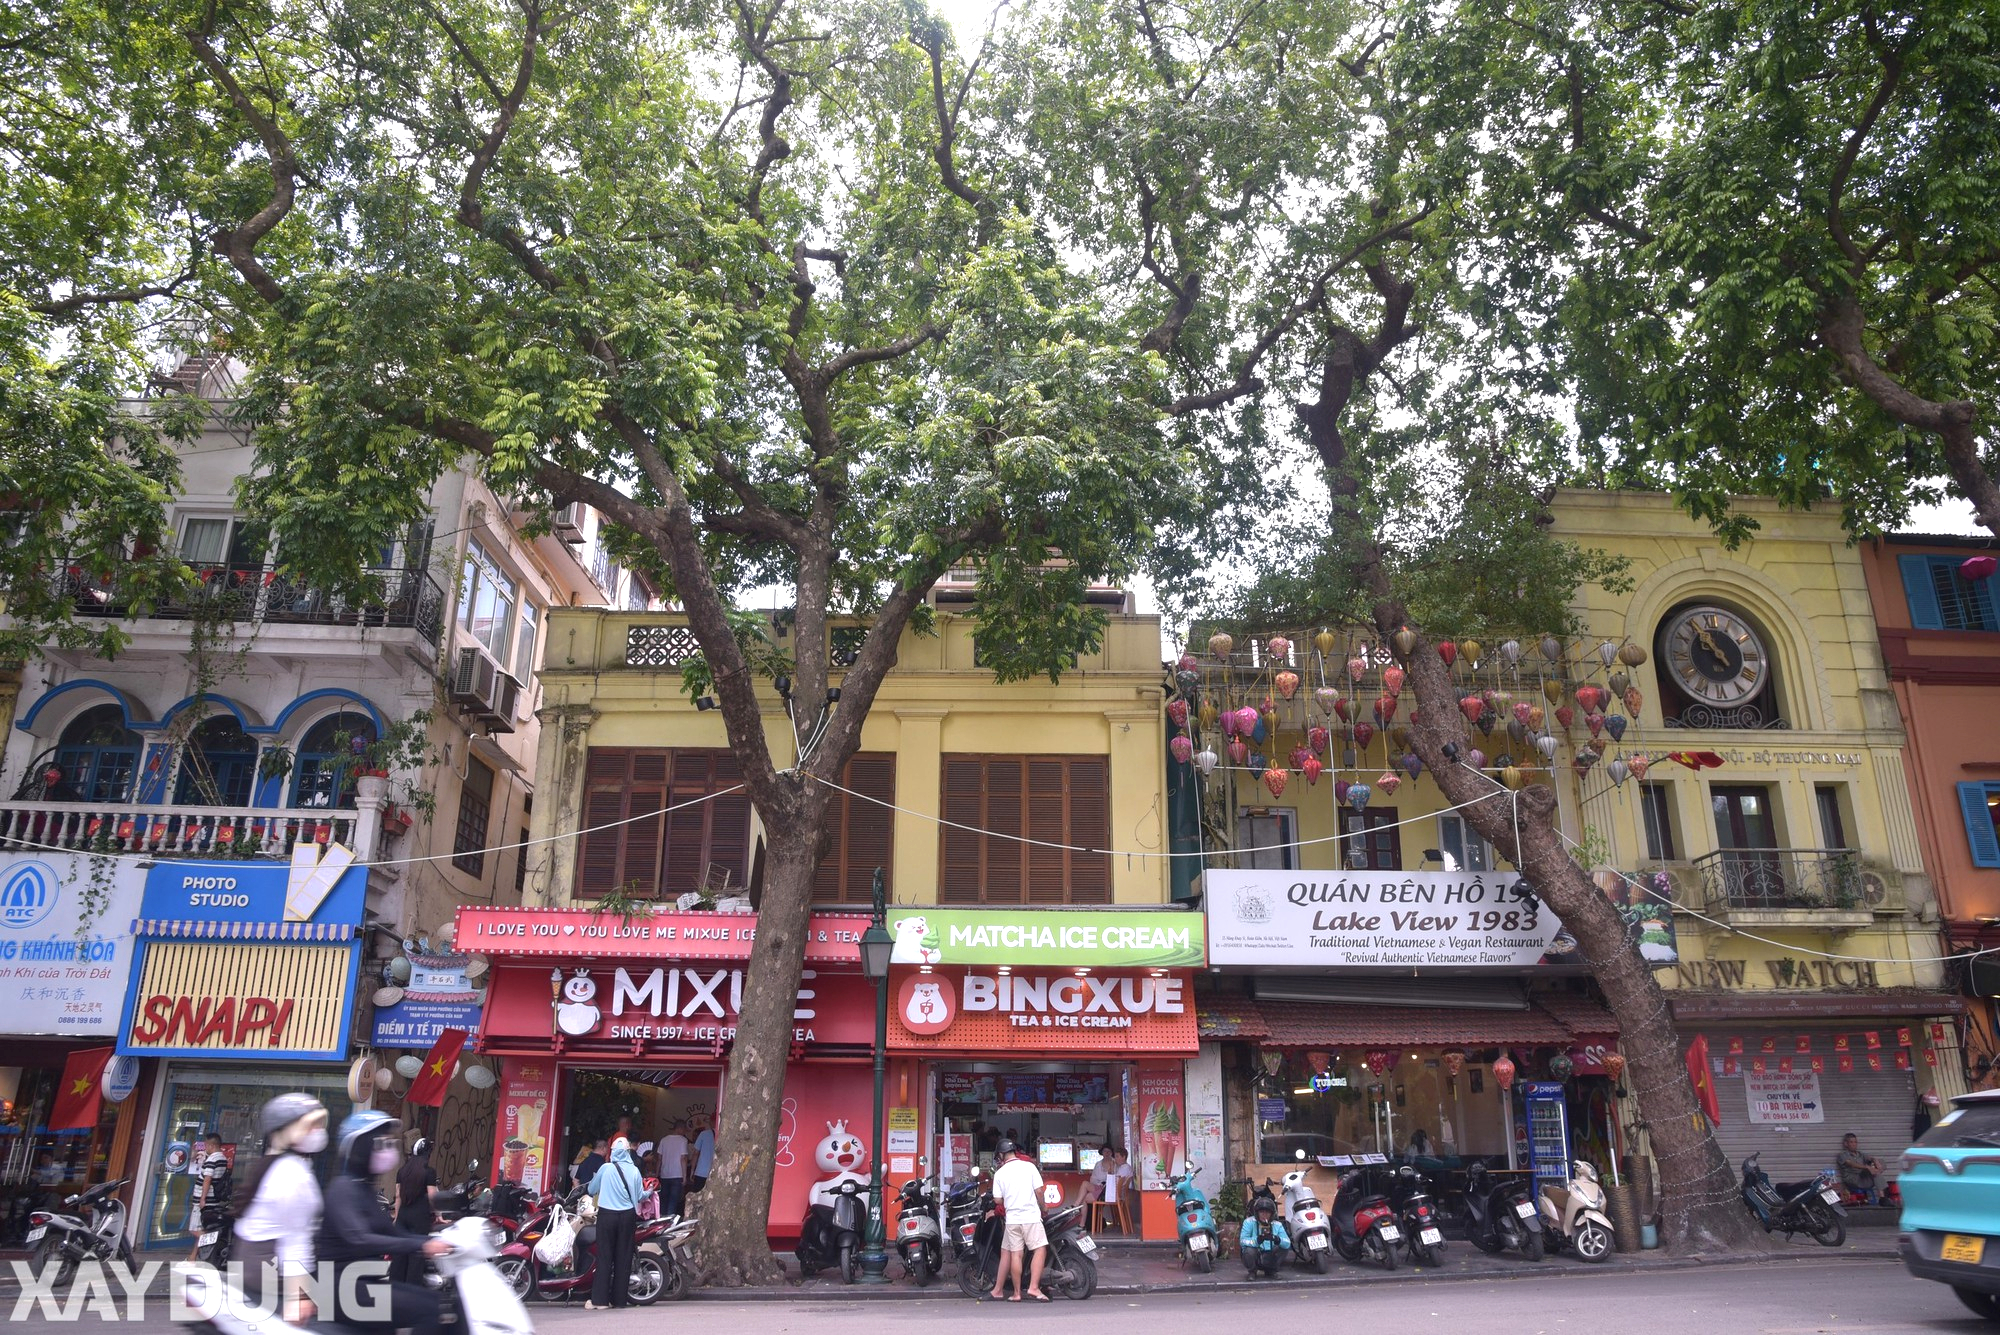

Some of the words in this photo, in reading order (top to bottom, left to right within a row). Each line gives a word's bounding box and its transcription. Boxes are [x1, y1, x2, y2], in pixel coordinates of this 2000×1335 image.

[182, 876, 237, 891] PHOTO
[1287, 878, 1371, 907] QUÁN
[1379, 879, 1437, 904] BÊN
[1444, 875, 1486, 905] HỒ
[189, 893, 250, 908] STUDIO
[5, 908, 35, 917] ATC
[1312, 910, 1381, 931] Lake
[1390, 910, 1457, 932] View
[1467, 910, 1538, 932] 1983
[477, 923, 483, 935] I
[488, 923, 526, 936] LOVE
[531, 924, 560, 937] YOU
[580, 925, 608, 938] YOU
[613, 925, 651, 939] LOVE
[656, 927, 677, 940] ME
[683, 927, 730, 941] MIXUE
[818, 930, 829, 943] &
[834, 930, 862, 944] TEA
[949, 924, 1056, 949] MATCHA
[1059, 926, 1098, 949] ICE
[1102, 926, 1190, 950] CREAM
[20, 934, 77, 962] KHÁNH
[78, 933, 116, 962] HÒA
[1309, 935, 1371, 949] Traditional
[1373, 935, 1436, 949] Vietnamese
[1448, 935, 1484, 951] Vegan
[1485, 935, 1545, 949] Restaurant
[1380, 951, 1424, 964] Authentic
[1426, 951, 1478, 964] Vietnamese
[38, 967, 60, 978] của
[89, 966, 112, 979] Đất
[1676, 960, 1748, 987] NEW
[1765, 960, 1880, 988] WATCH
[963, 975, 1184, 1014] BINGXUE
[134, 994, 295, 1045] SNAP!
[1010, 1015, 1038, 1027] TEA
[1041, 1016, 1052, 1027] &
[1055, 1015, 1079, 1028] ICE
[1081, 1016, 1132, 1028] CREAM
[377, 1019, 405, 1035] ĐIỂM
[408, 1023, 416, 1036] Y
[417, 1020, 430, 1036] TẾ
[611, 1026, 652, 1039] SINCE
[656, 1026, 683, 1040] 1997
[694, 1027, 716, 1041] ICE
[792, 1028, 816, 1041] EA
[1142, 1087, 1179, 1095] MATCHA
[1540, 1085, 1562, 1093] pepsi
[1757, 1102, 1769, 1111] 10
